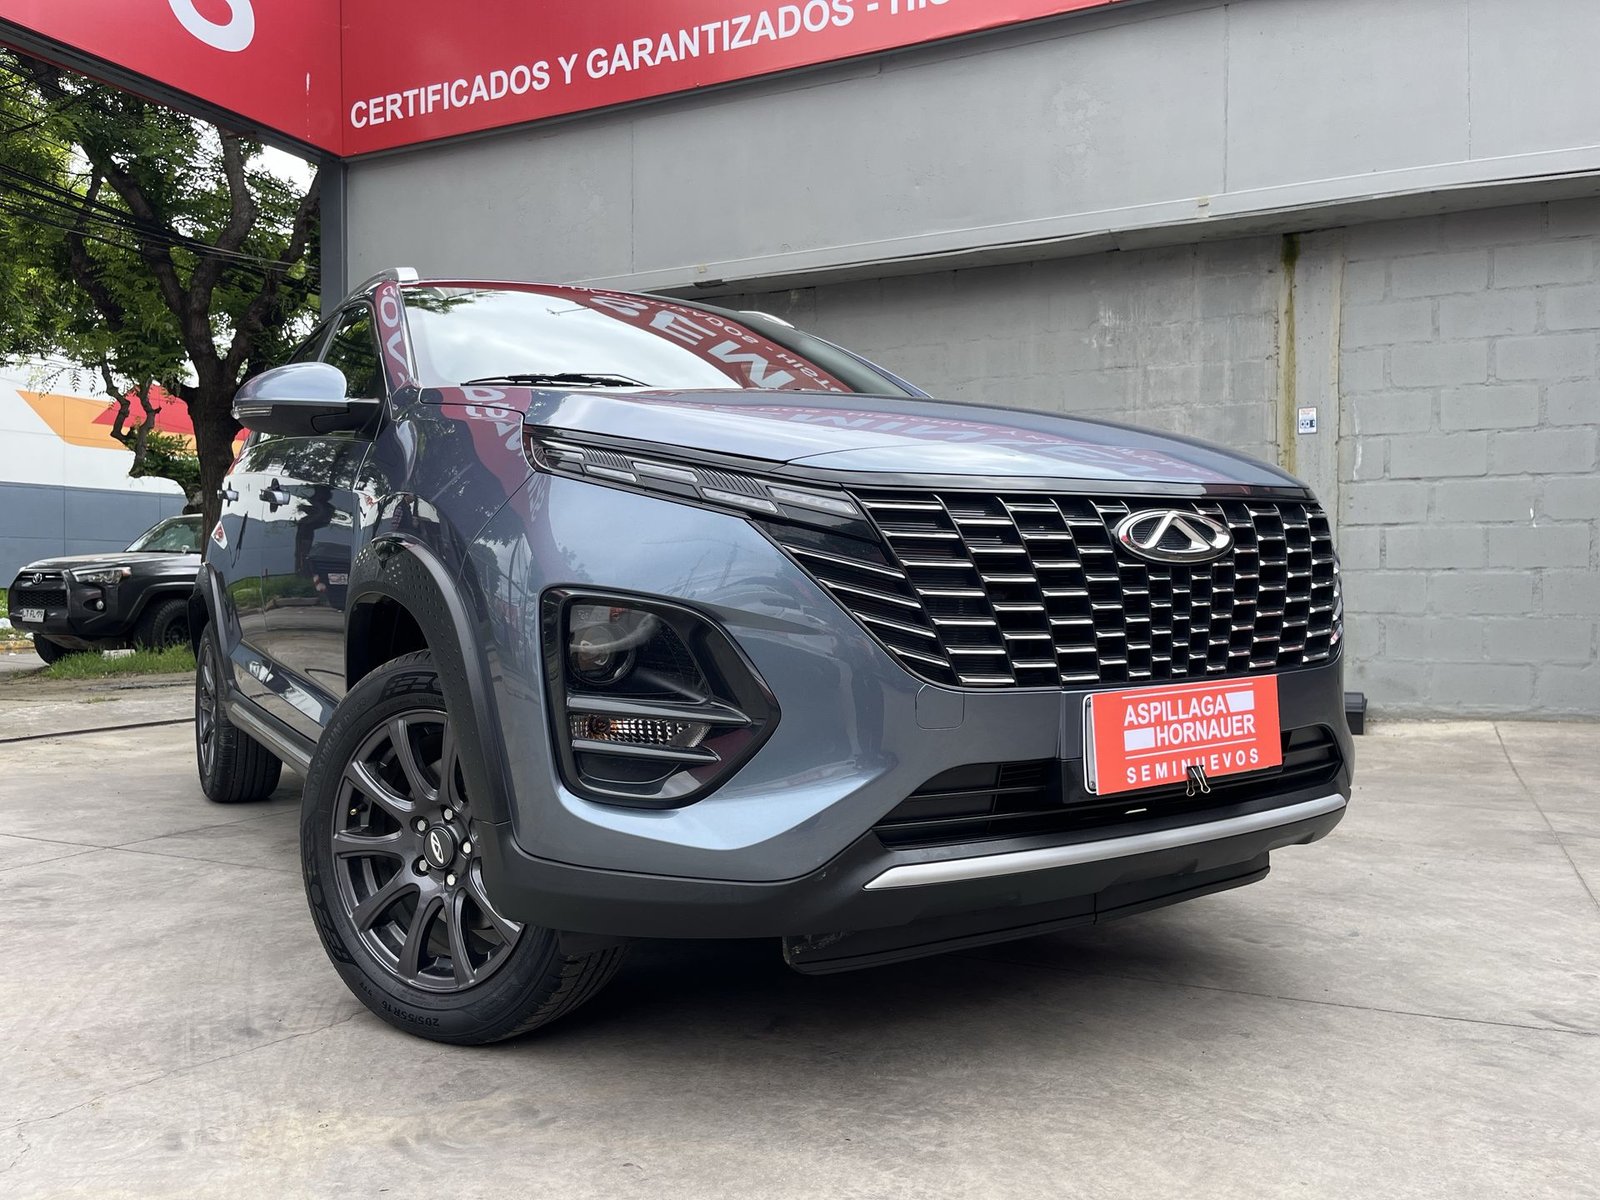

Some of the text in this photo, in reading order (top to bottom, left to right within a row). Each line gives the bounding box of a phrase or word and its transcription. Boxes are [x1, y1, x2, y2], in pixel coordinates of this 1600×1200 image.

[350, 60, 552, 129] CERTIFICADOS
[557, 54, 579, 85] Y
[586, 0, 855, 80] GARANTIZADOS
[1124, 696, 1226, 726] ASPILLAGA
[1157, 715, 1255, 746] HORNAUER
